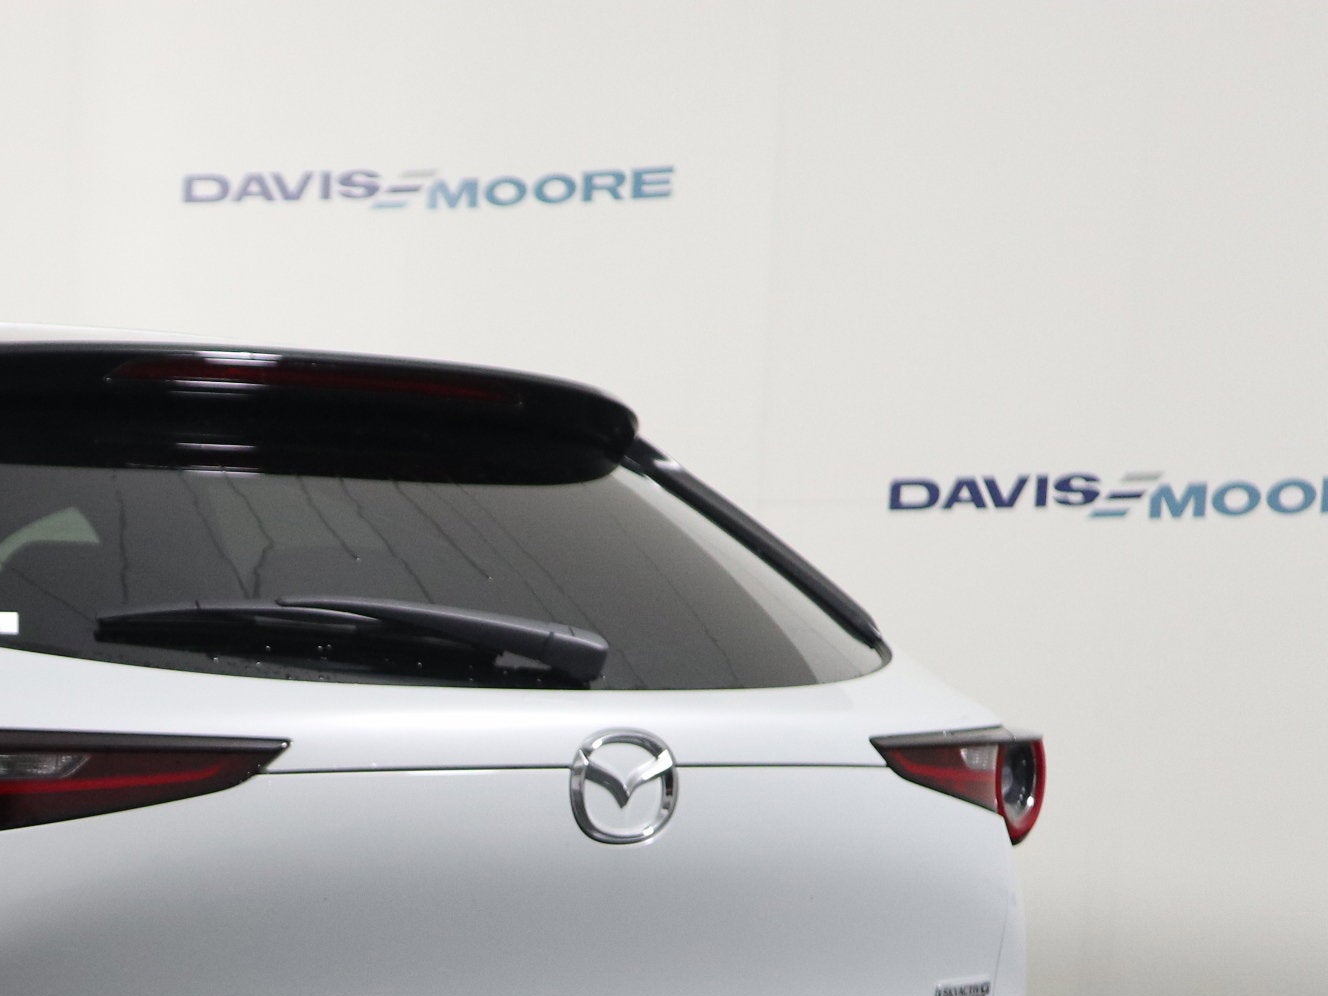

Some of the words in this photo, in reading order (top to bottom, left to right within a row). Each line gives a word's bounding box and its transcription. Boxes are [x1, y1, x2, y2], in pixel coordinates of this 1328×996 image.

[182, 168, 380, 203] DAVIS
[426, 165, 676, 209] MOORE
[887, 472, 1102, 511] DAVIS
[1148, 476, 1328, 519] MOO
